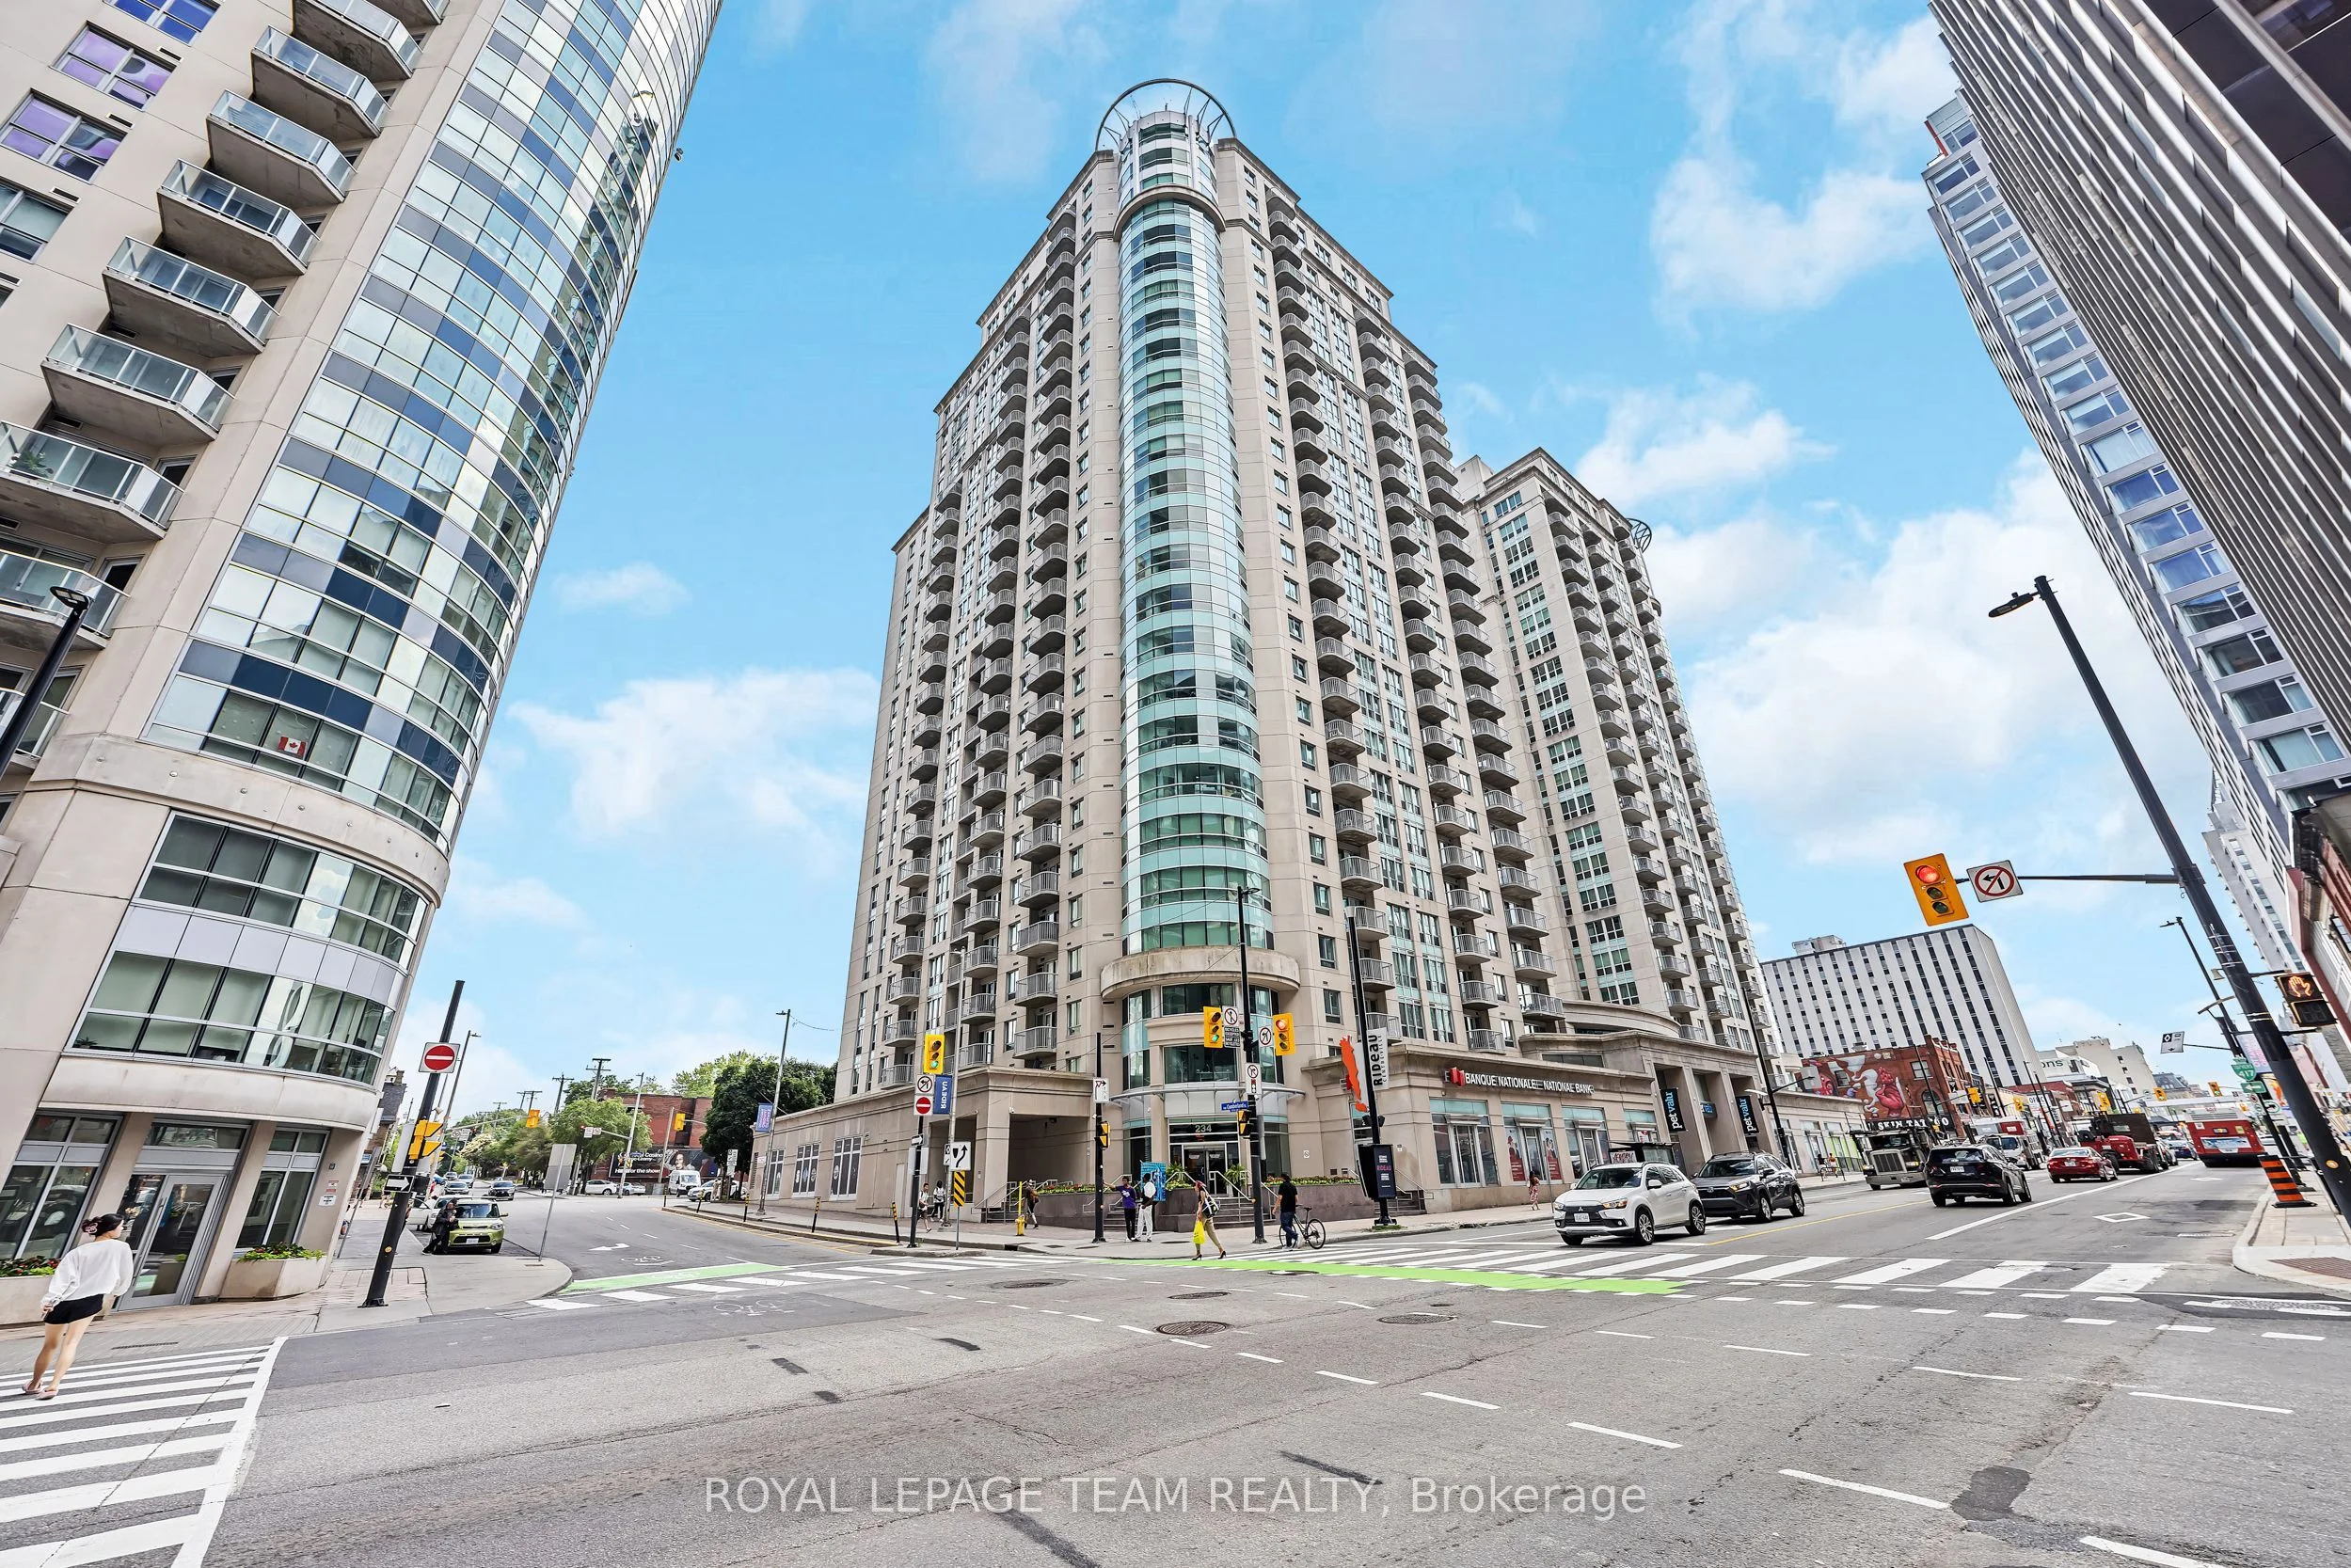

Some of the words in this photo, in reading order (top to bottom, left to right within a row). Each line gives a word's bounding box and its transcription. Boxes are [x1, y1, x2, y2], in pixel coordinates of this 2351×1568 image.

[1465, 1072, 1497, 1086] BANQUE
[1498, 1076, 1536, 1089] NATIONALE
[1543, 1080, 1576, 1092] NATIONAL
[1576, 1083, 1595, 1094] BANK
[1665, 1091, 1676, 1113] valu
[1739, 1099, 1751, 1117] valu
[1195, 1124, 1213, 1132] 234
[1668, 1113, 1683, 1129] pet
[1743, 1117, 1757, 1132] pet
[1877, 1120, 1903, 1131] SKIN
[1905, 1117, 1949, 1128] TATOO
